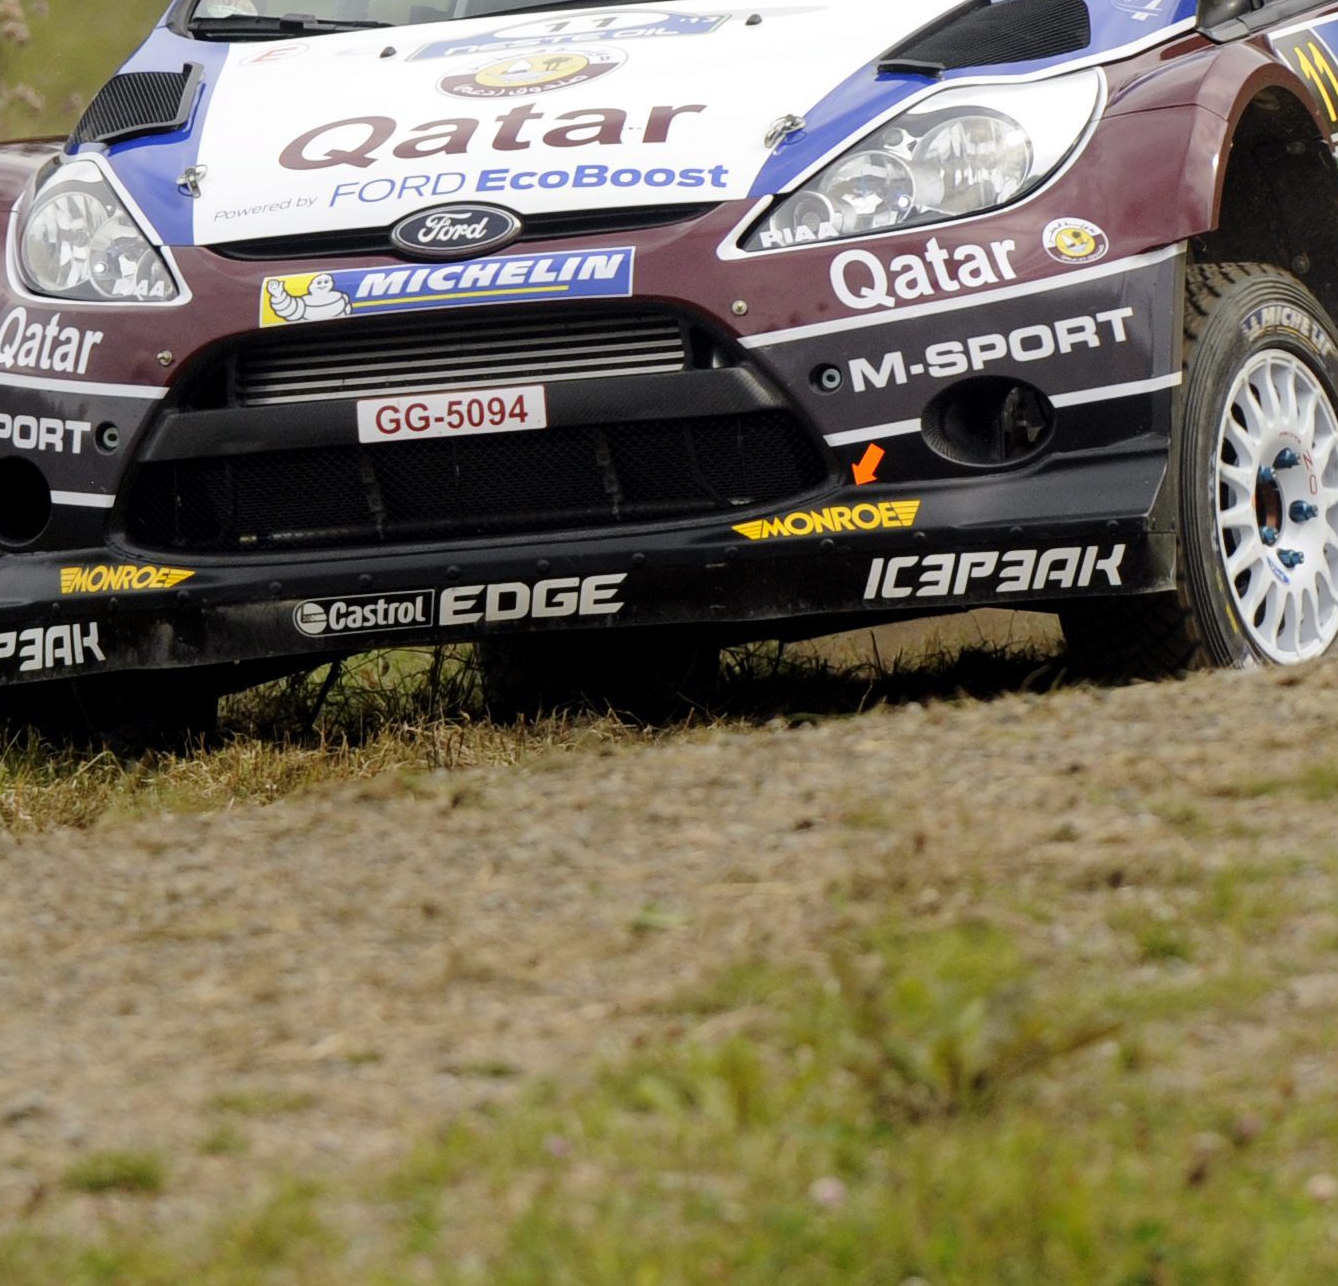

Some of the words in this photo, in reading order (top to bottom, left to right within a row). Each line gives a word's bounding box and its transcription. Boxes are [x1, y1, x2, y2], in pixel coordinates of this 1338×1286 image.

[544, 15, 619, 33] 11
[613, 26, 679, 38] OIL
[278, 103, 708, 171] Qatar
[214, 199, 292, 222] Powered
[296, 196, 318, 209] by
[329, 172, 465, 208] FORD
[475, 164, 729, 193] EcoBoost
[416, 212, 488, 244] Ford
[759, 222, 840, 248] RIAA
[355, 253, 624, 298] MICHELIN
[829, 236, 1016, 311] Qatar
[848, 306, 1134, 393] M-SPORT
[375, 394, 529, 435] GG-5094
[761, 500, 900, 538] MONROE
[71, 565, 170, 594] MONROE
[864, 543, 1126, 600] ICEPEAK
[329, 595, 426, 630] Castrol
[439, 572, 628, 627] EDGE
